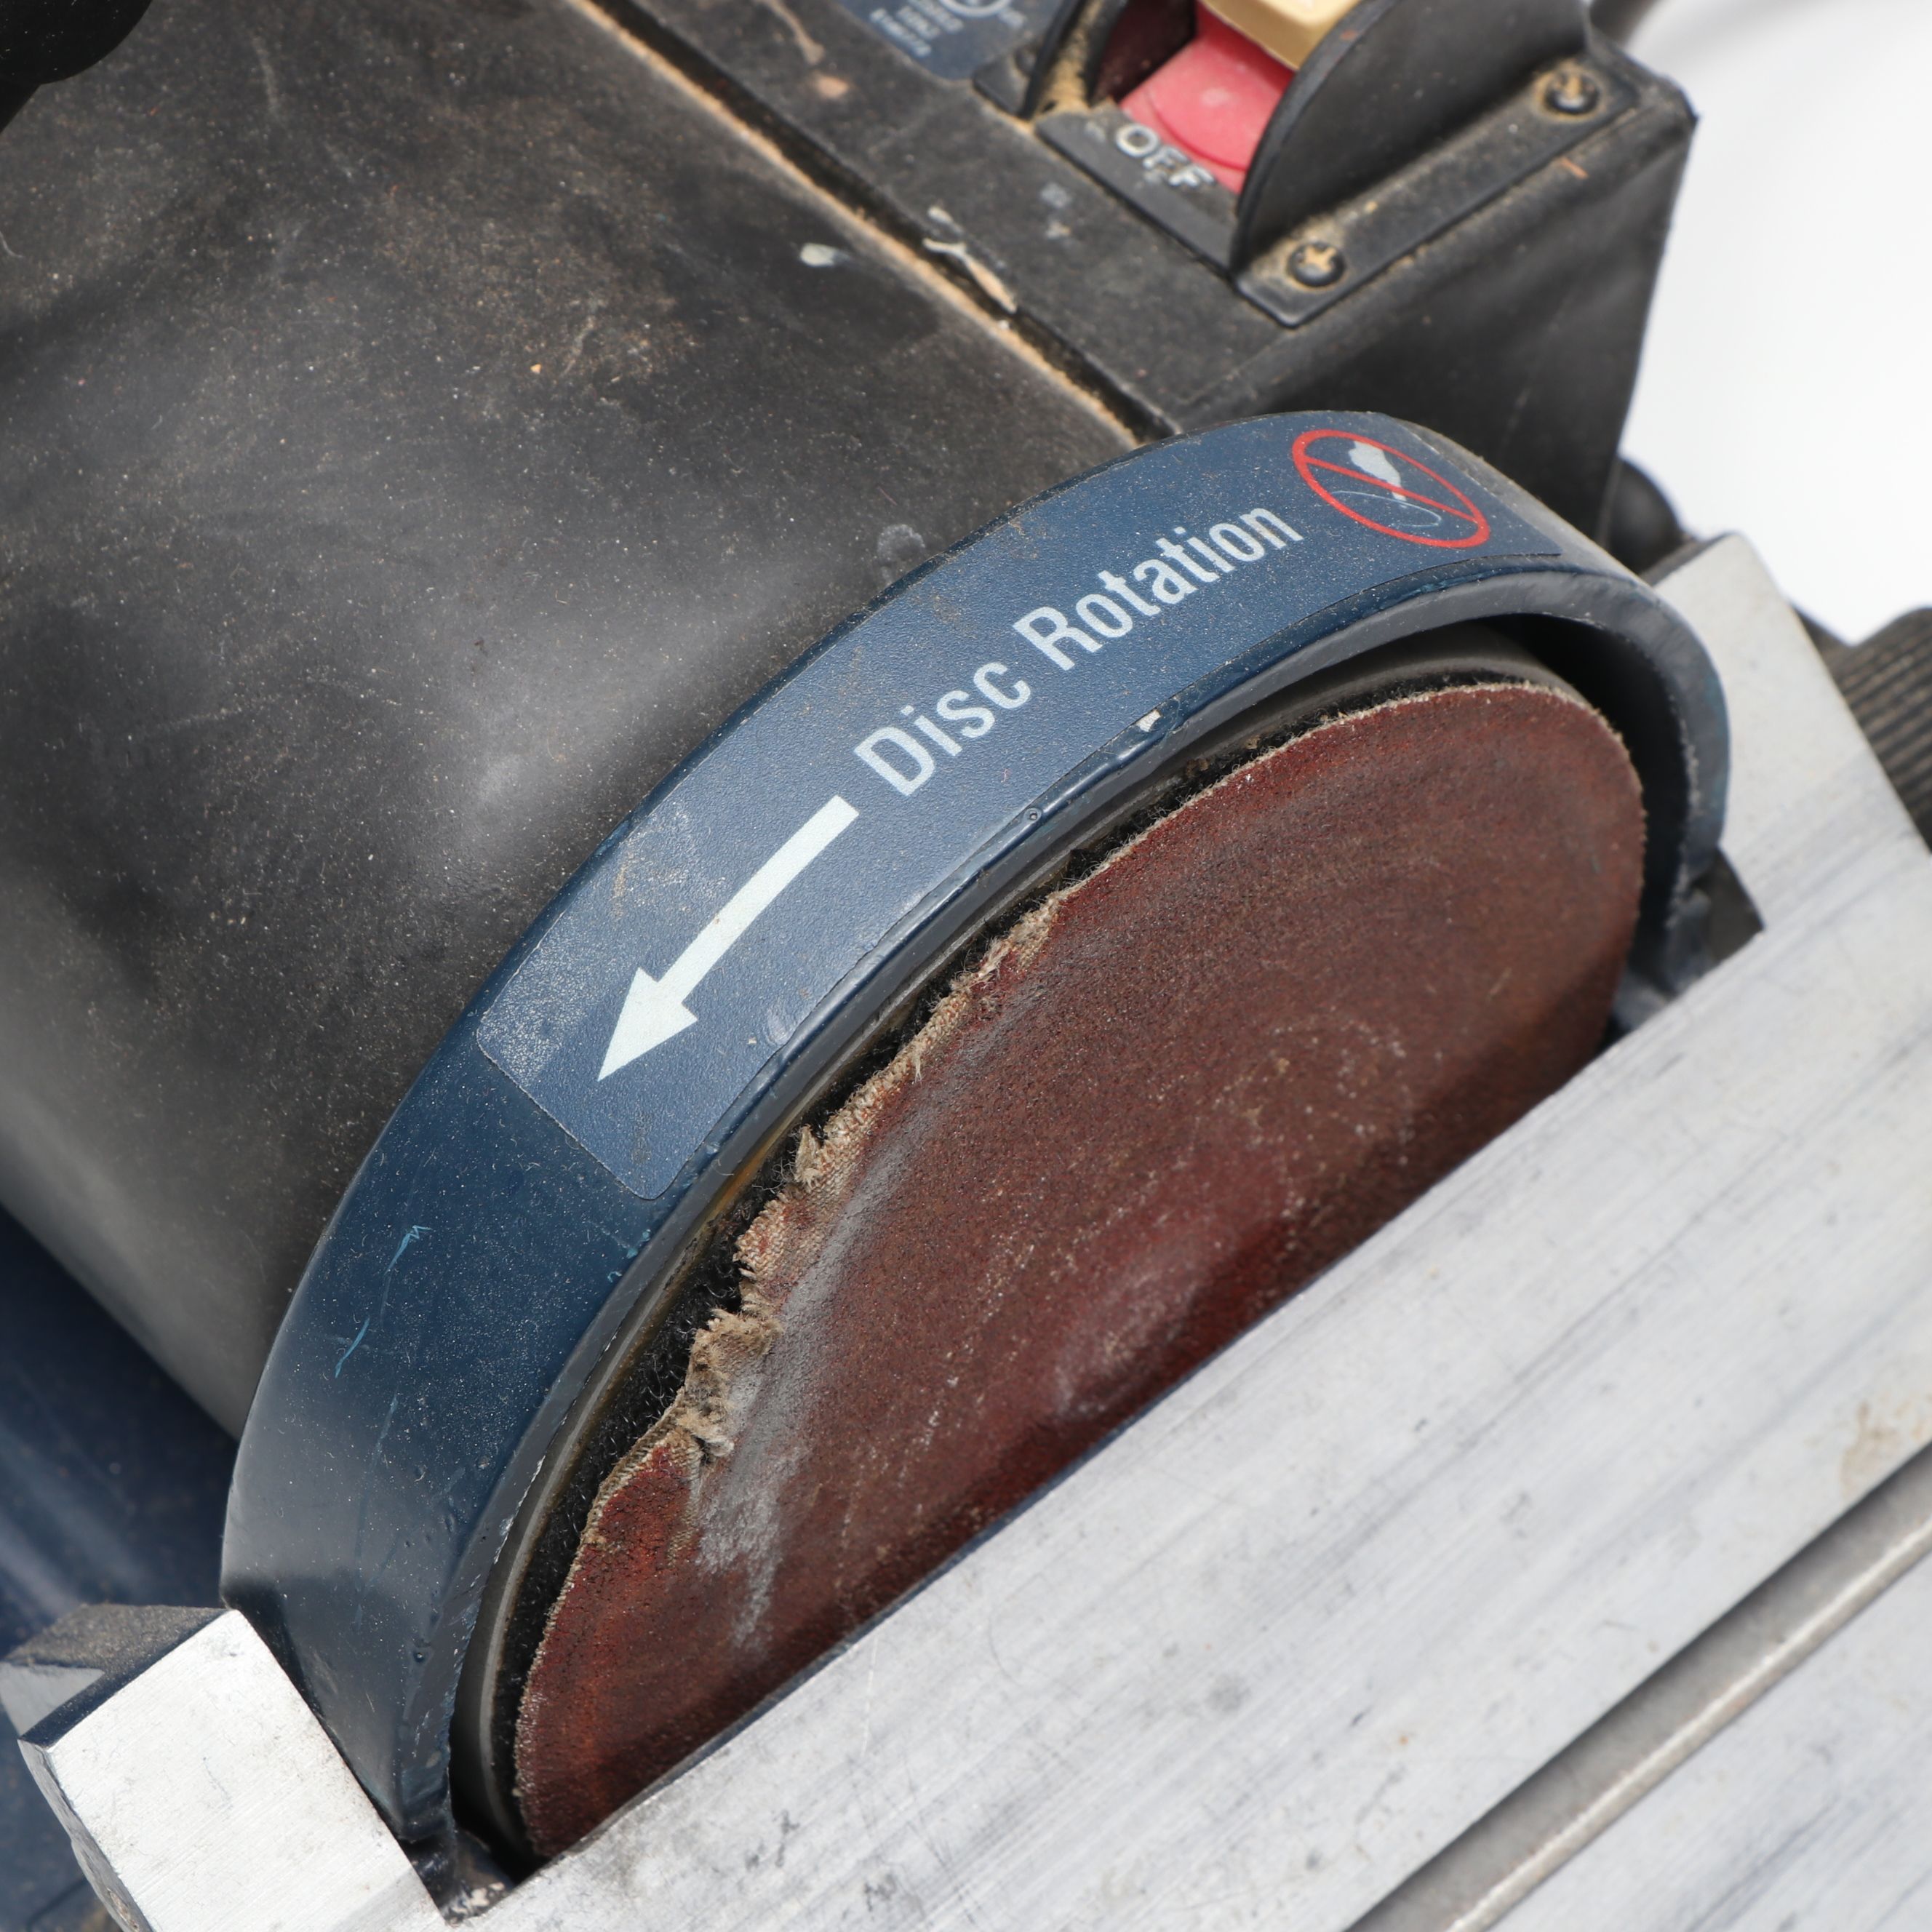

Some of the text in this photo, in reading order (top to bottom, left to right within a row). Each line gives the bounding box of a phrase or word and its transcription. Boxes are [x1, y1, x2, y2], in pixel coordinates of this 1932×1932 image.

[1115, 124, 1216, 187] OFF
[854, 508, 1303, 796] Disc Rotation
